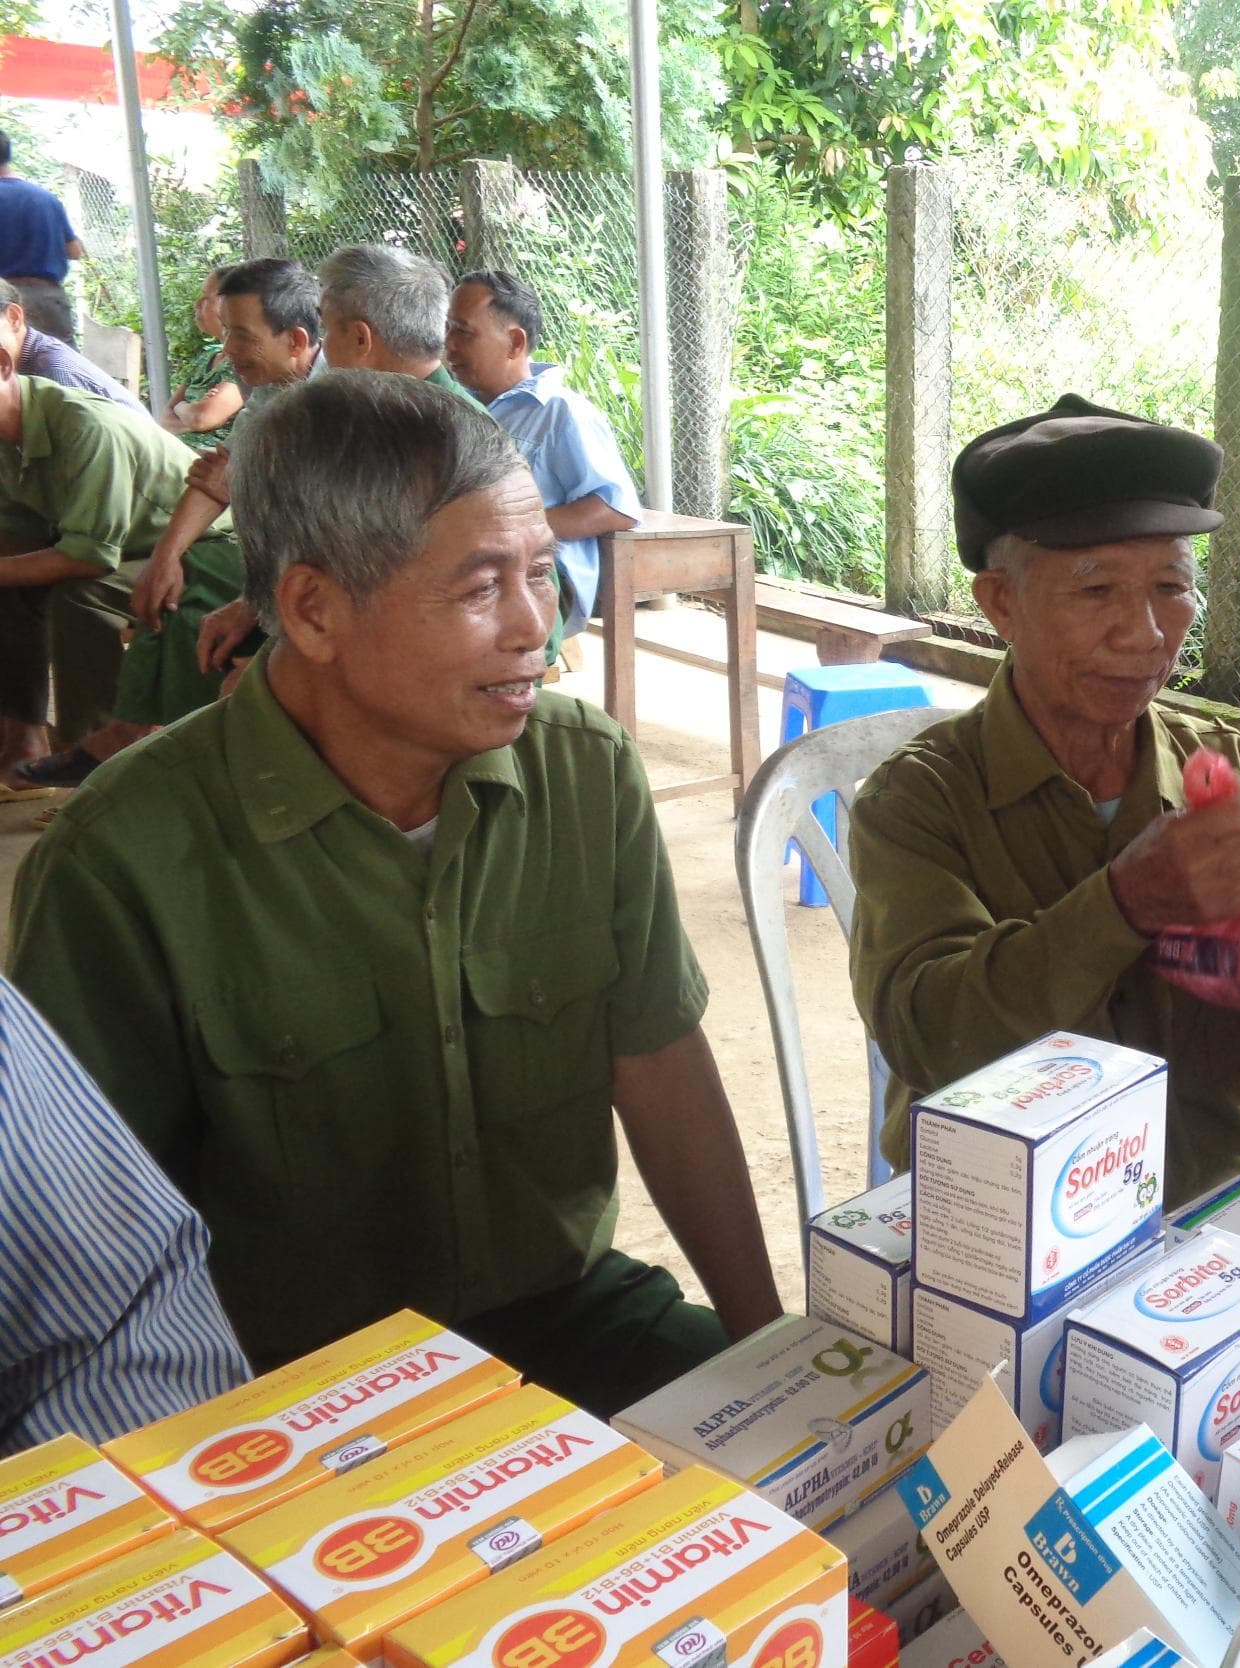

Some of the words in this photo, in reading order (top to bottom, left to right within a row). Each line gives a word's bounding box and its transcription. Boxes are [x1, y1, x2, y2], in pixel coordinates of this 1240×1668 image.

[1009, 1064, 1092, 1111] Sorbitol
[1066, 1122, 1149, 1200] Sorbitol
[1123, 1159, 1144, 1186] 5g
[1146, 1253, 1230, 1309] Sorbitol
[288, 1349, 456, 1433] Vitamin
[689, 1399, 752, 1436] ALPHA
[195, 1435, 283, 1482] 3B
[419, 1431, 588, 1524] Vitamin
[784, 1467, 830, 1512] ALPHA
[919, 1493, 946, 1522] Brawn
[936, 1496, 976, 1544] Omeprazole
[972, 1440, 1024, 1502] Delayed-Release
[320, 1522, 410, 1576] 3B
[946, 1524, 978, 1562] Capsules
[975, 1506, 991, 1529] USP
[1034, 1531, 1080, 1592] Brawn
[597, 1515, 767, 1620] Vitamin
[1004, 1566, 1074, 1656] Capsules
[1018, 1551, 1104, 1657] Omeprazol
[500, 1616, 593, 1668] 3B
